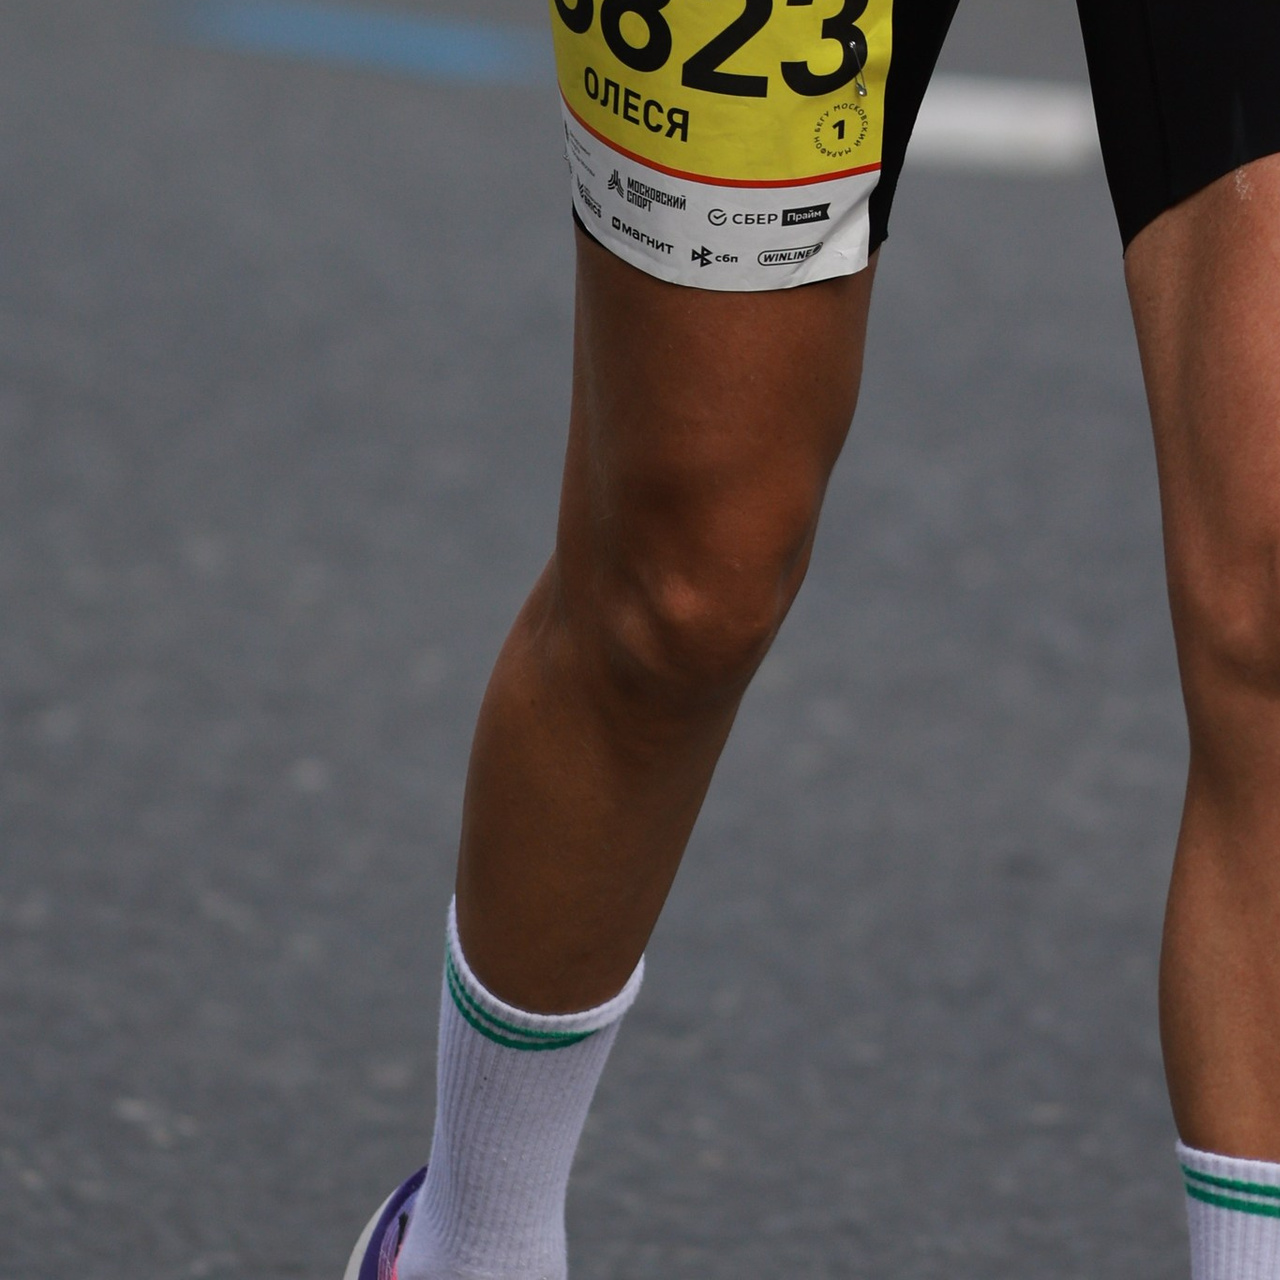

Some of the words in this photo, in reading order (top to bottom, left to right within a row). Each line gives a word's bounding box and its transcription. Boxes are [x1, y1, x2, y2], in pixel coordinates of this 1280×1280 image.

[584, 67, 690, 142] ОЛЕСЯ
[832, 119, 845, 140] 1
[626, 177, 687, 211] МОСКОВСКИЙ
[626, 190, 653, 212] СПОРТ
[732, 213, 778, 225] СБЕР
[787, 209, 822, 222] Прайм
[763, 248, 813, 263] WINLINE
